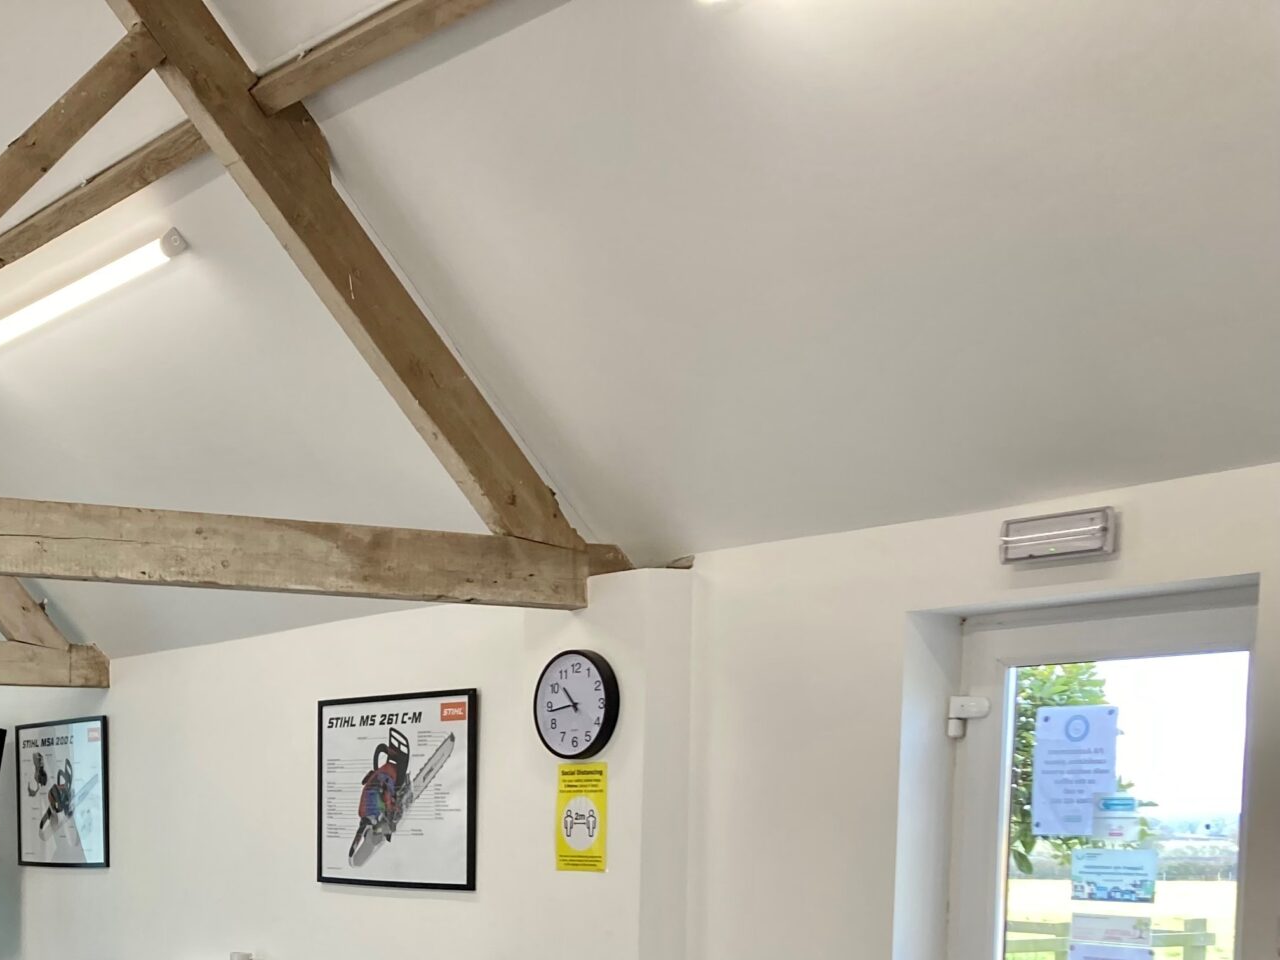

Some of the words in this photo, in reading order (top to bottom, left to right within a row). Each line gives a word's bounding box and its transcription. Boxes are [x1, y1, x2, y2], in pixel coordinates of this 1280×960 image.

[571, 662, 581, 673] 12
[586, 667, 591, 677] 1
[559, 669, 568, 680] 11
[550, 682, 560, 694] 10
[594, 680, 601, 691] 2
[546, 701, 553, 712] 9
[598, 698, 605, 709] 3
[442, 708, 464, 716] STIHL
[327, 717, 356, 728] STIHL
[360, 715, 376, 726] MS
[379, 713, 398, 725] 261
[401, 712, 423, 724] C-M
[550, 718, 557, 730] 8
[594, 716, 600, 726] 4
[560, 731, 566, 742] 7
[584, 730, 591, 742] 5
[22, 739, 39, 749] STIHL
[41, 737, 54, 747] MSA
[571, 736, 578, 748] 6
[574, 812, 586, 820] 2m
